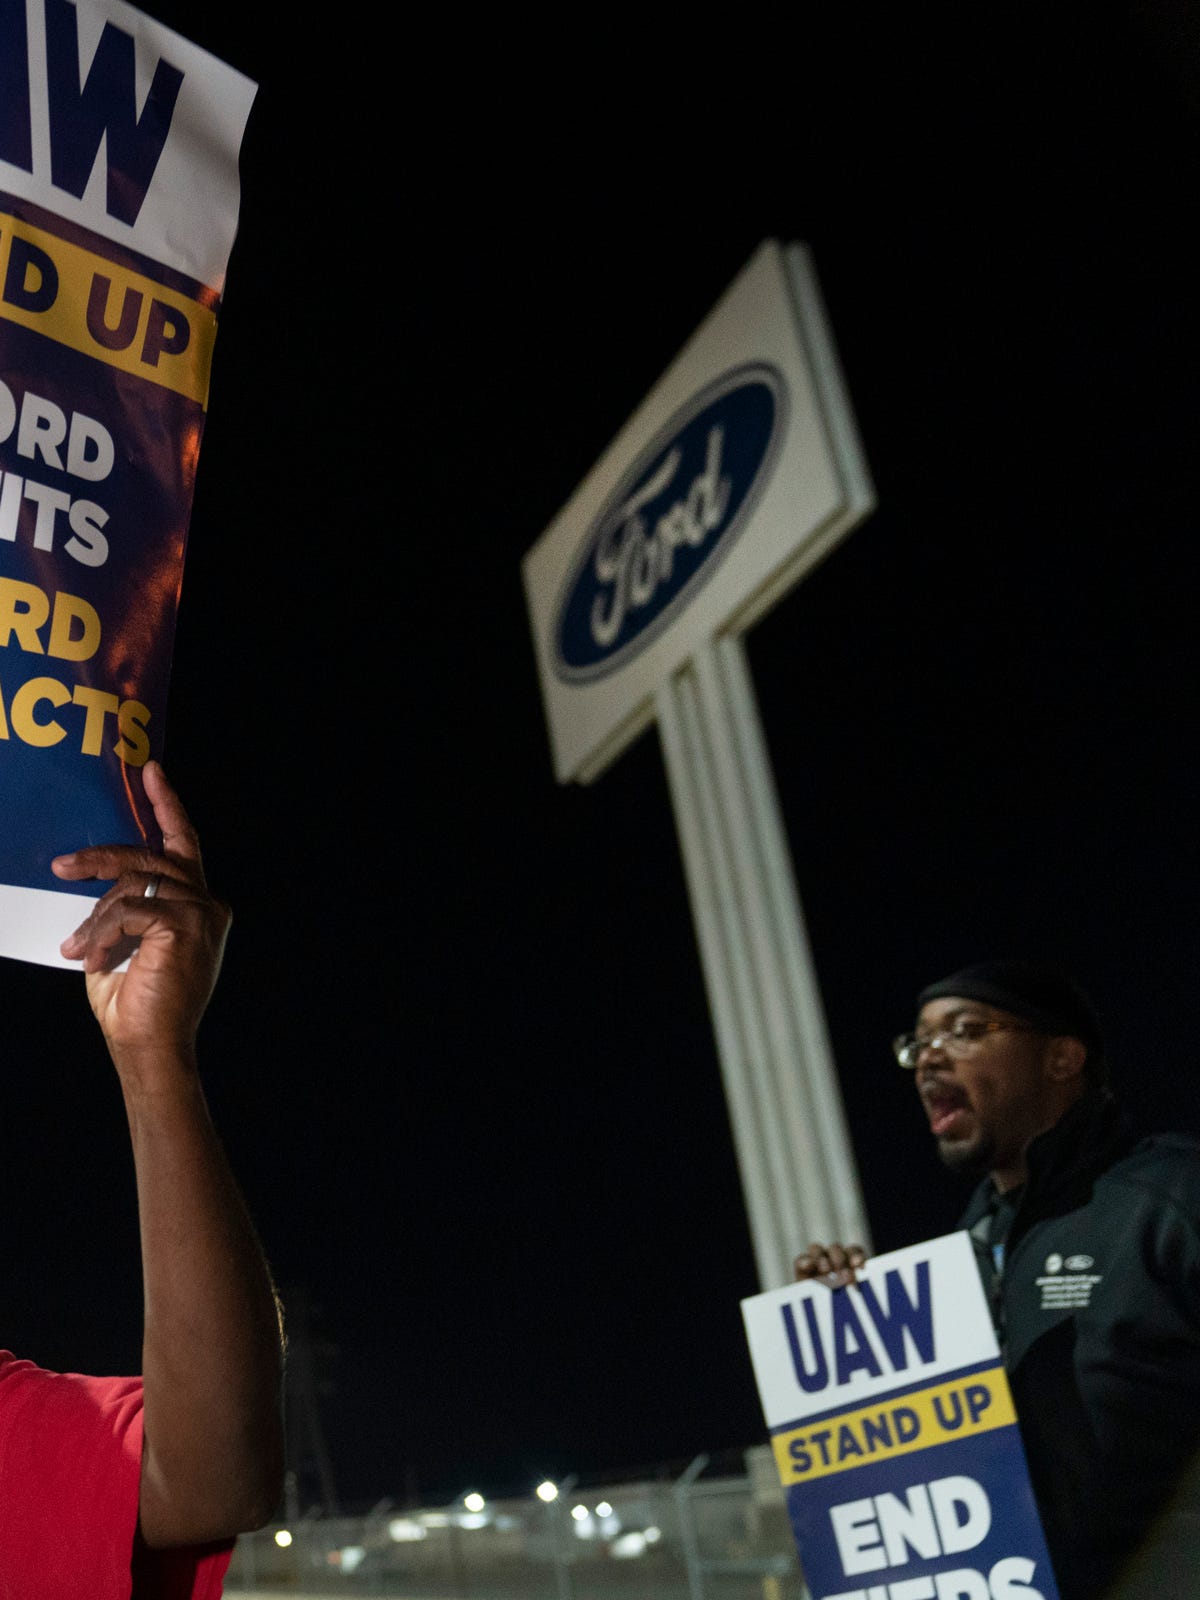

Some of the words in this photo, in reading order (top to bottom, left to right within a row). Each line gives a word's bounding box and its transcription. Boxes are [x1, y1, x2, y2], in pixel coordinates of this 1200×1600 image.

[85, 272, 191, 367] UP
[590, 424, 732, 648] Ford
[780, 1260, 937, 1394] UAW
[788, 1408, 921, 1474] STAND
[932, 1384, 992, 1431] UP
[829, 1475, 992, 1577] END
